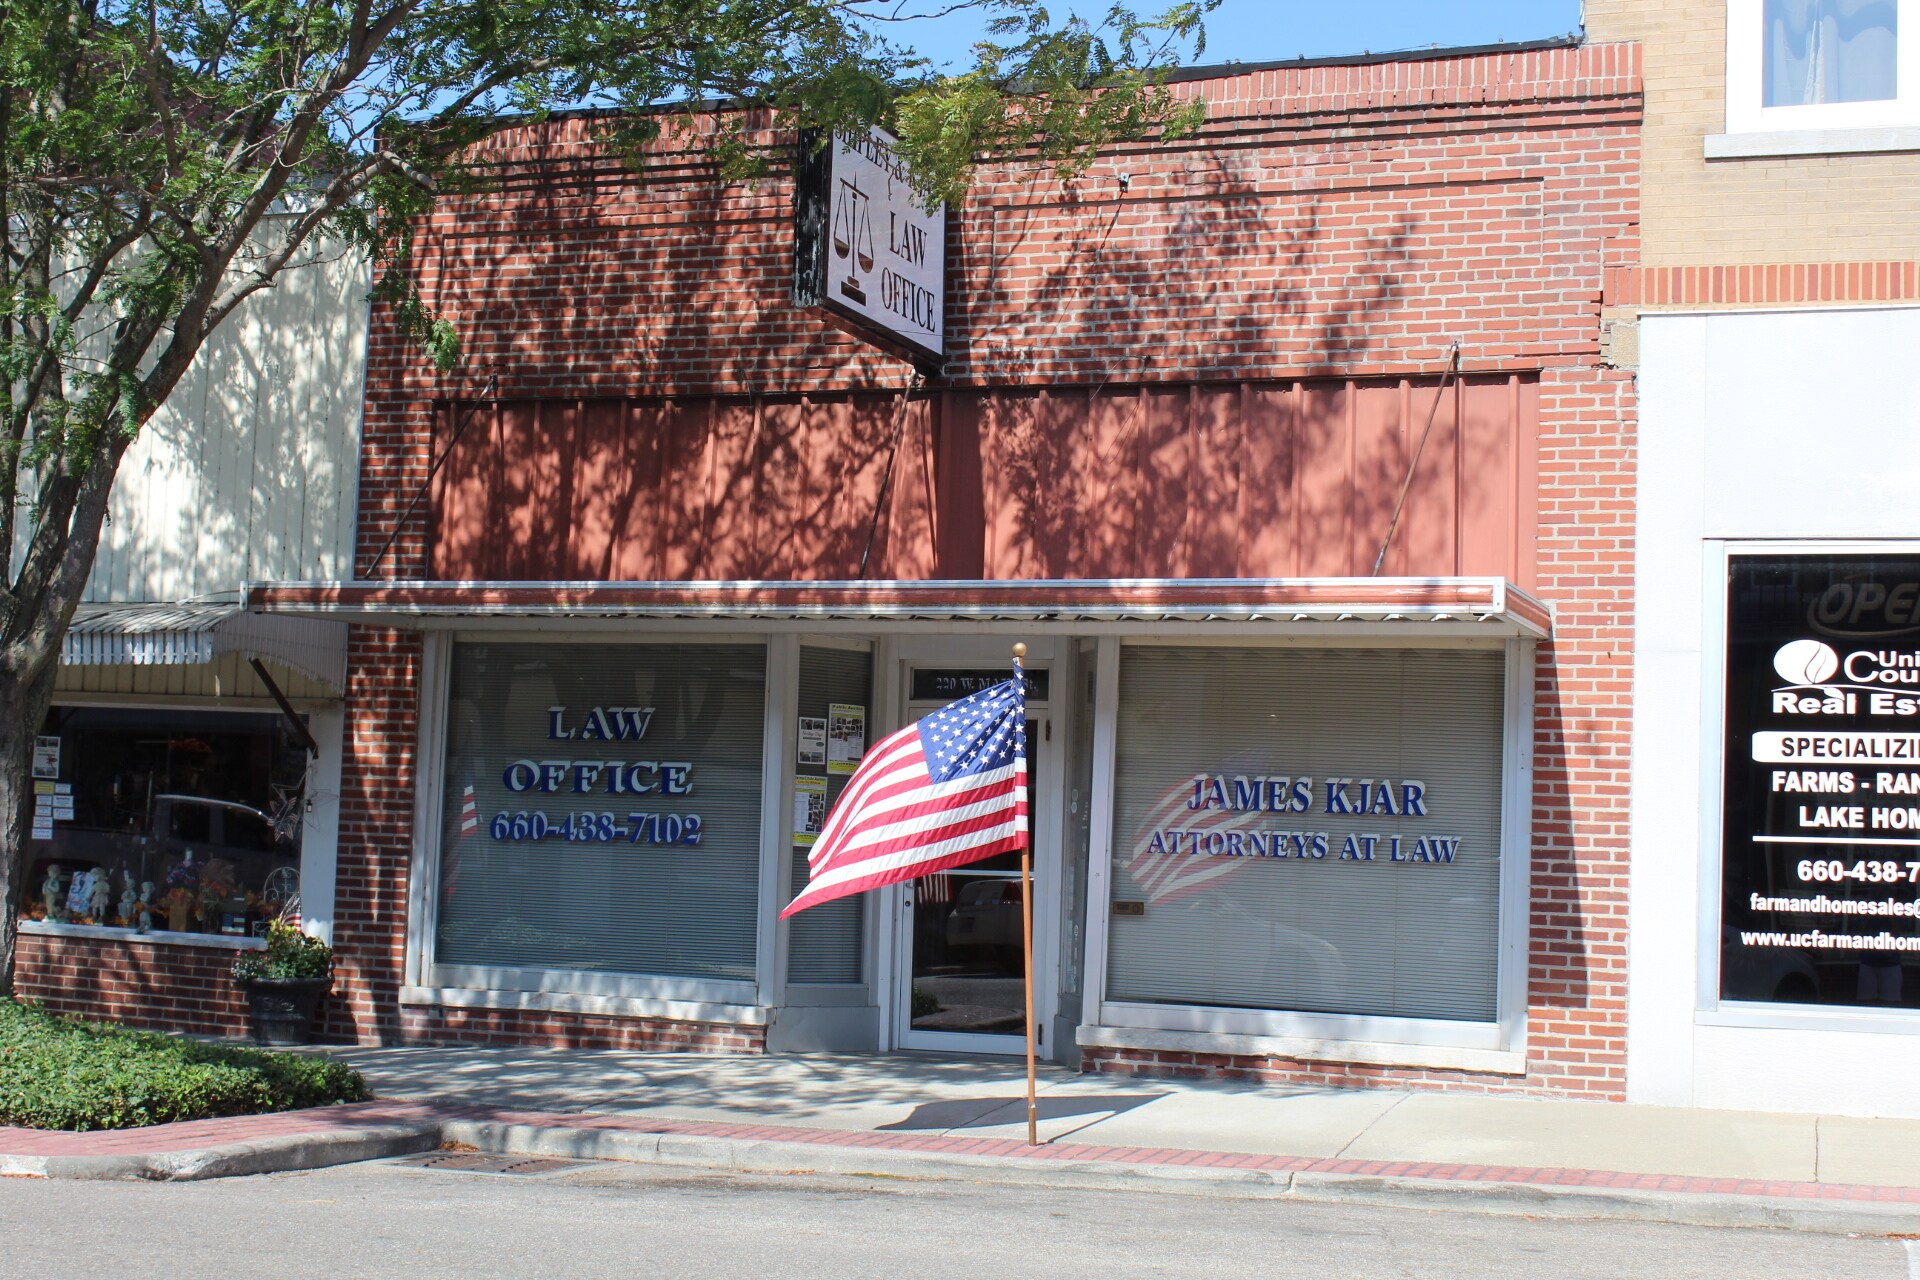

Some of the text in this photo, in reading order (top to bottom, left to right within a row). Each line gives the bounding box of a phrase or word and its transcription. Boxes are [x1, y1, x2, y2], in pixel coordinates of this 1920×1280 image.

[889, 211, 928, 269] LAW
[881, 266, 936, 333] OFFICE
[936, 677, 956, 690] 220
[1773, 693, 1920, 716] Real Es
[546, 706, 656, 740] LAW
[1781, 737, 1920, 758] SPECIALIZI
[503, 759, 693, 795] OFFICE
[1772, 771, 1854, 793] FARMS
[1187, 772, 1428, 816] JAMES KJAR
[489, 810, 702, 844] 660-438-7102
[1799, 806, 1864, 828] LAKE
[1146, 830, 1462, 863] ATTORNEYS AT LAW
